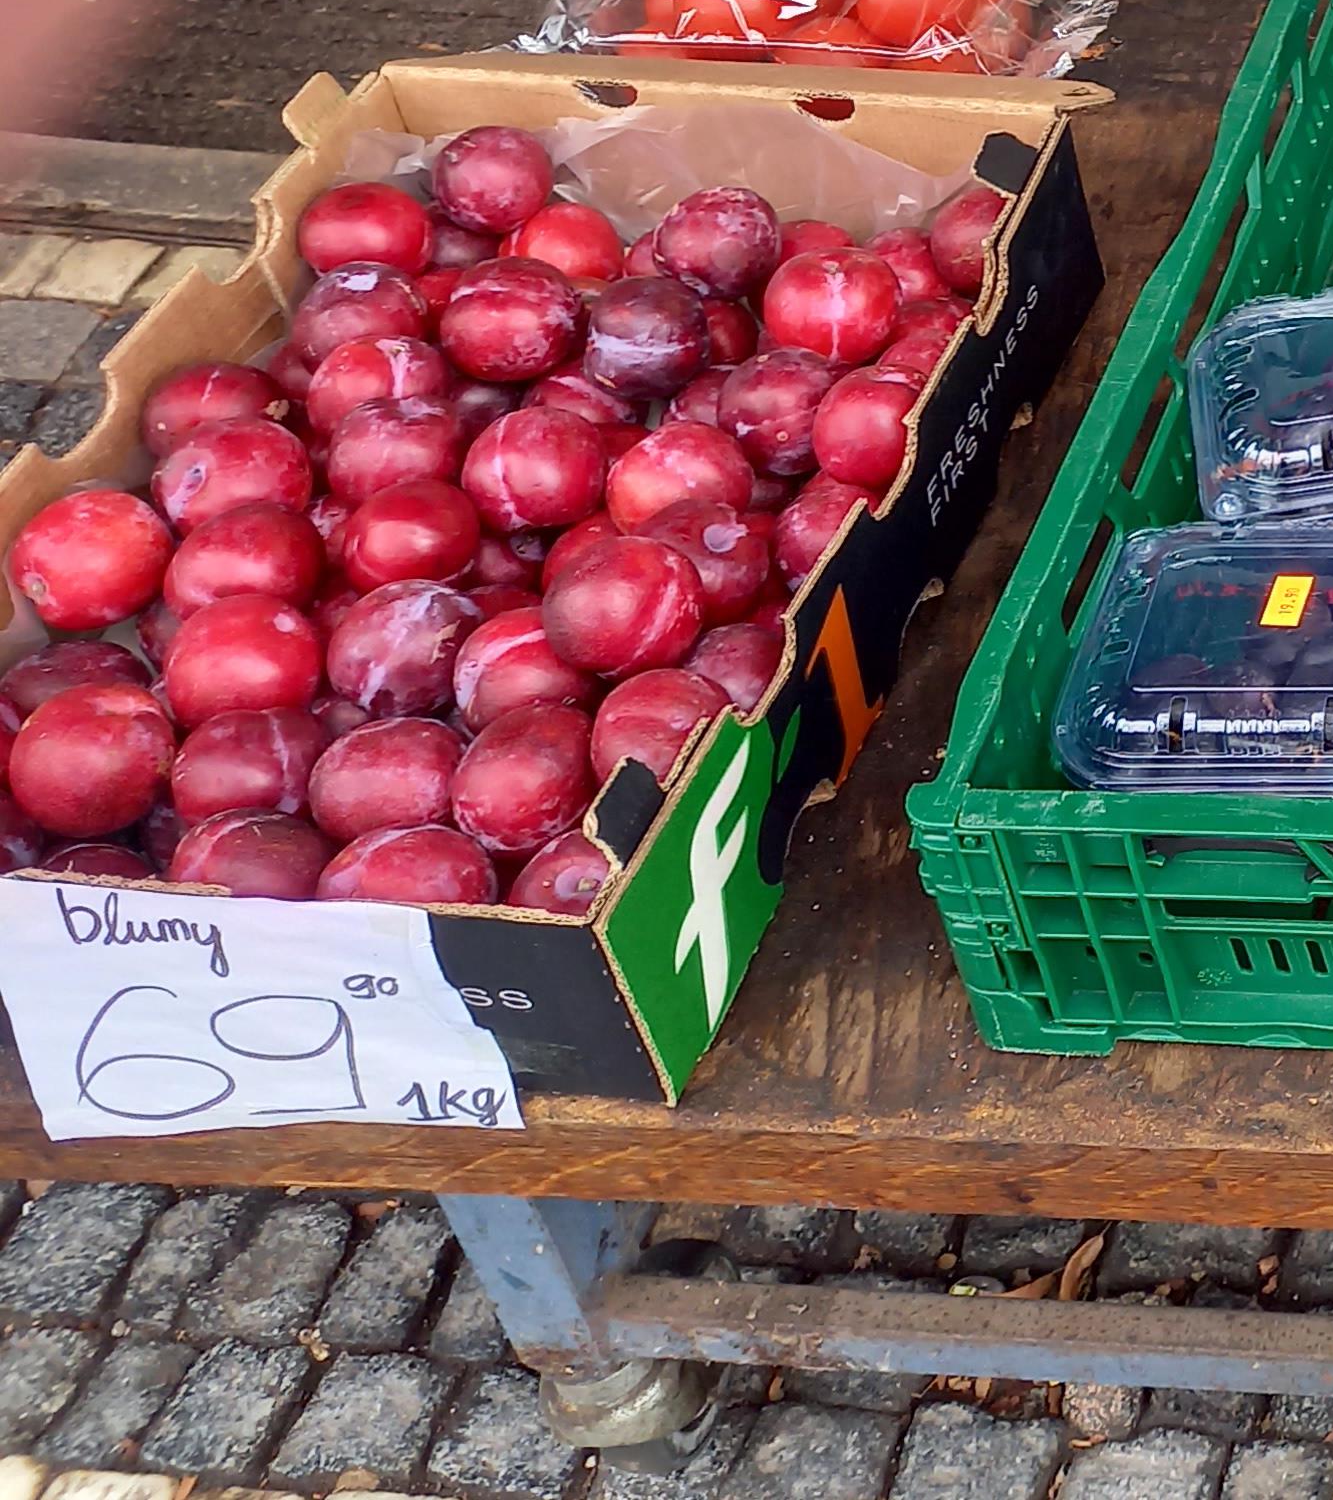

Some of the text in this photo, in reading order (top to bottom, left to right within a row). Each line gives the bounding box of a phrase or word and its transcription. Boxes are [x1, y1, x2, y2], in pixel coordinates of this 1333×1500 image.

[926, 284, 1039, 504] FRESHNESS
[930, 408, 990, 527] FIRST
[56, 887, 230, 978] blumy
[77, 985, 367, 1121] 69
